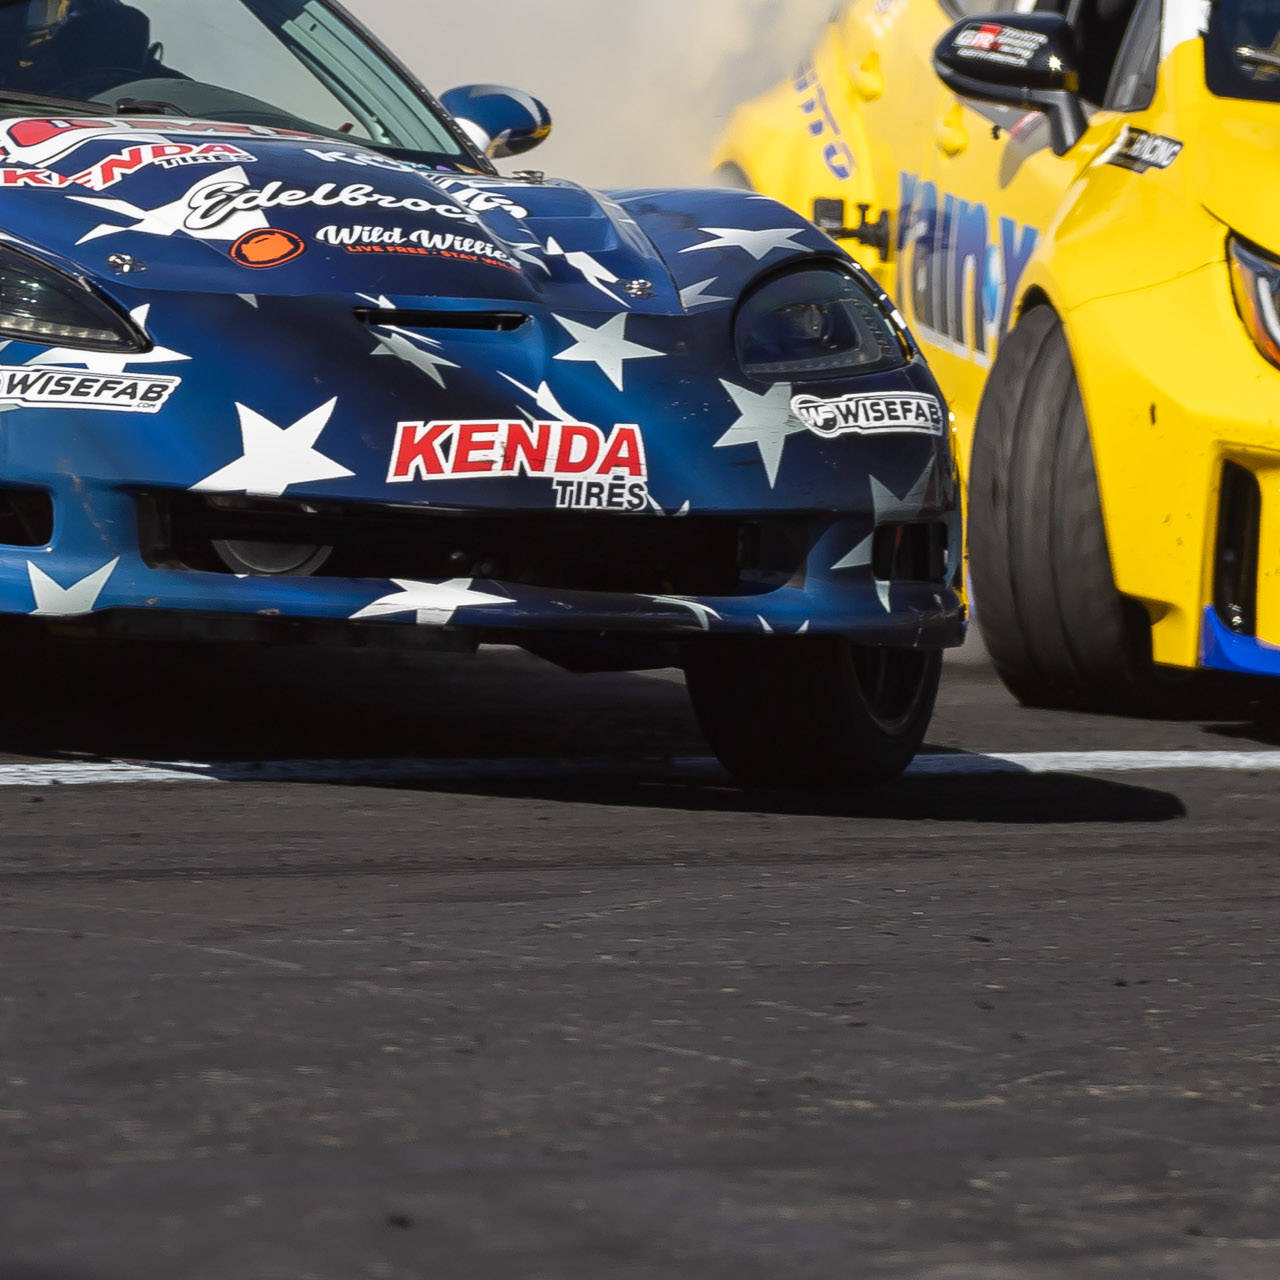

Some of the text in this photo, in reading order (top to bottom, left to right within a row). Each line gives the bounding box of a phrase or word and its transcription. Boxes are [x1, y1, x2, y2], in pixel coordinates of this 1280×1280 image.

[153, 153, 258, 169] TIRES
[184, 181, 482, 230] Edelbroc
[316, 225, 410, 245] Wild
[6, 370, 170, 402] WISEFAB
[835, 399, 942, 426] WISEFAB
[390, 421, 646, 480] KENDA
[554, 480, 647, 511] TIRES
